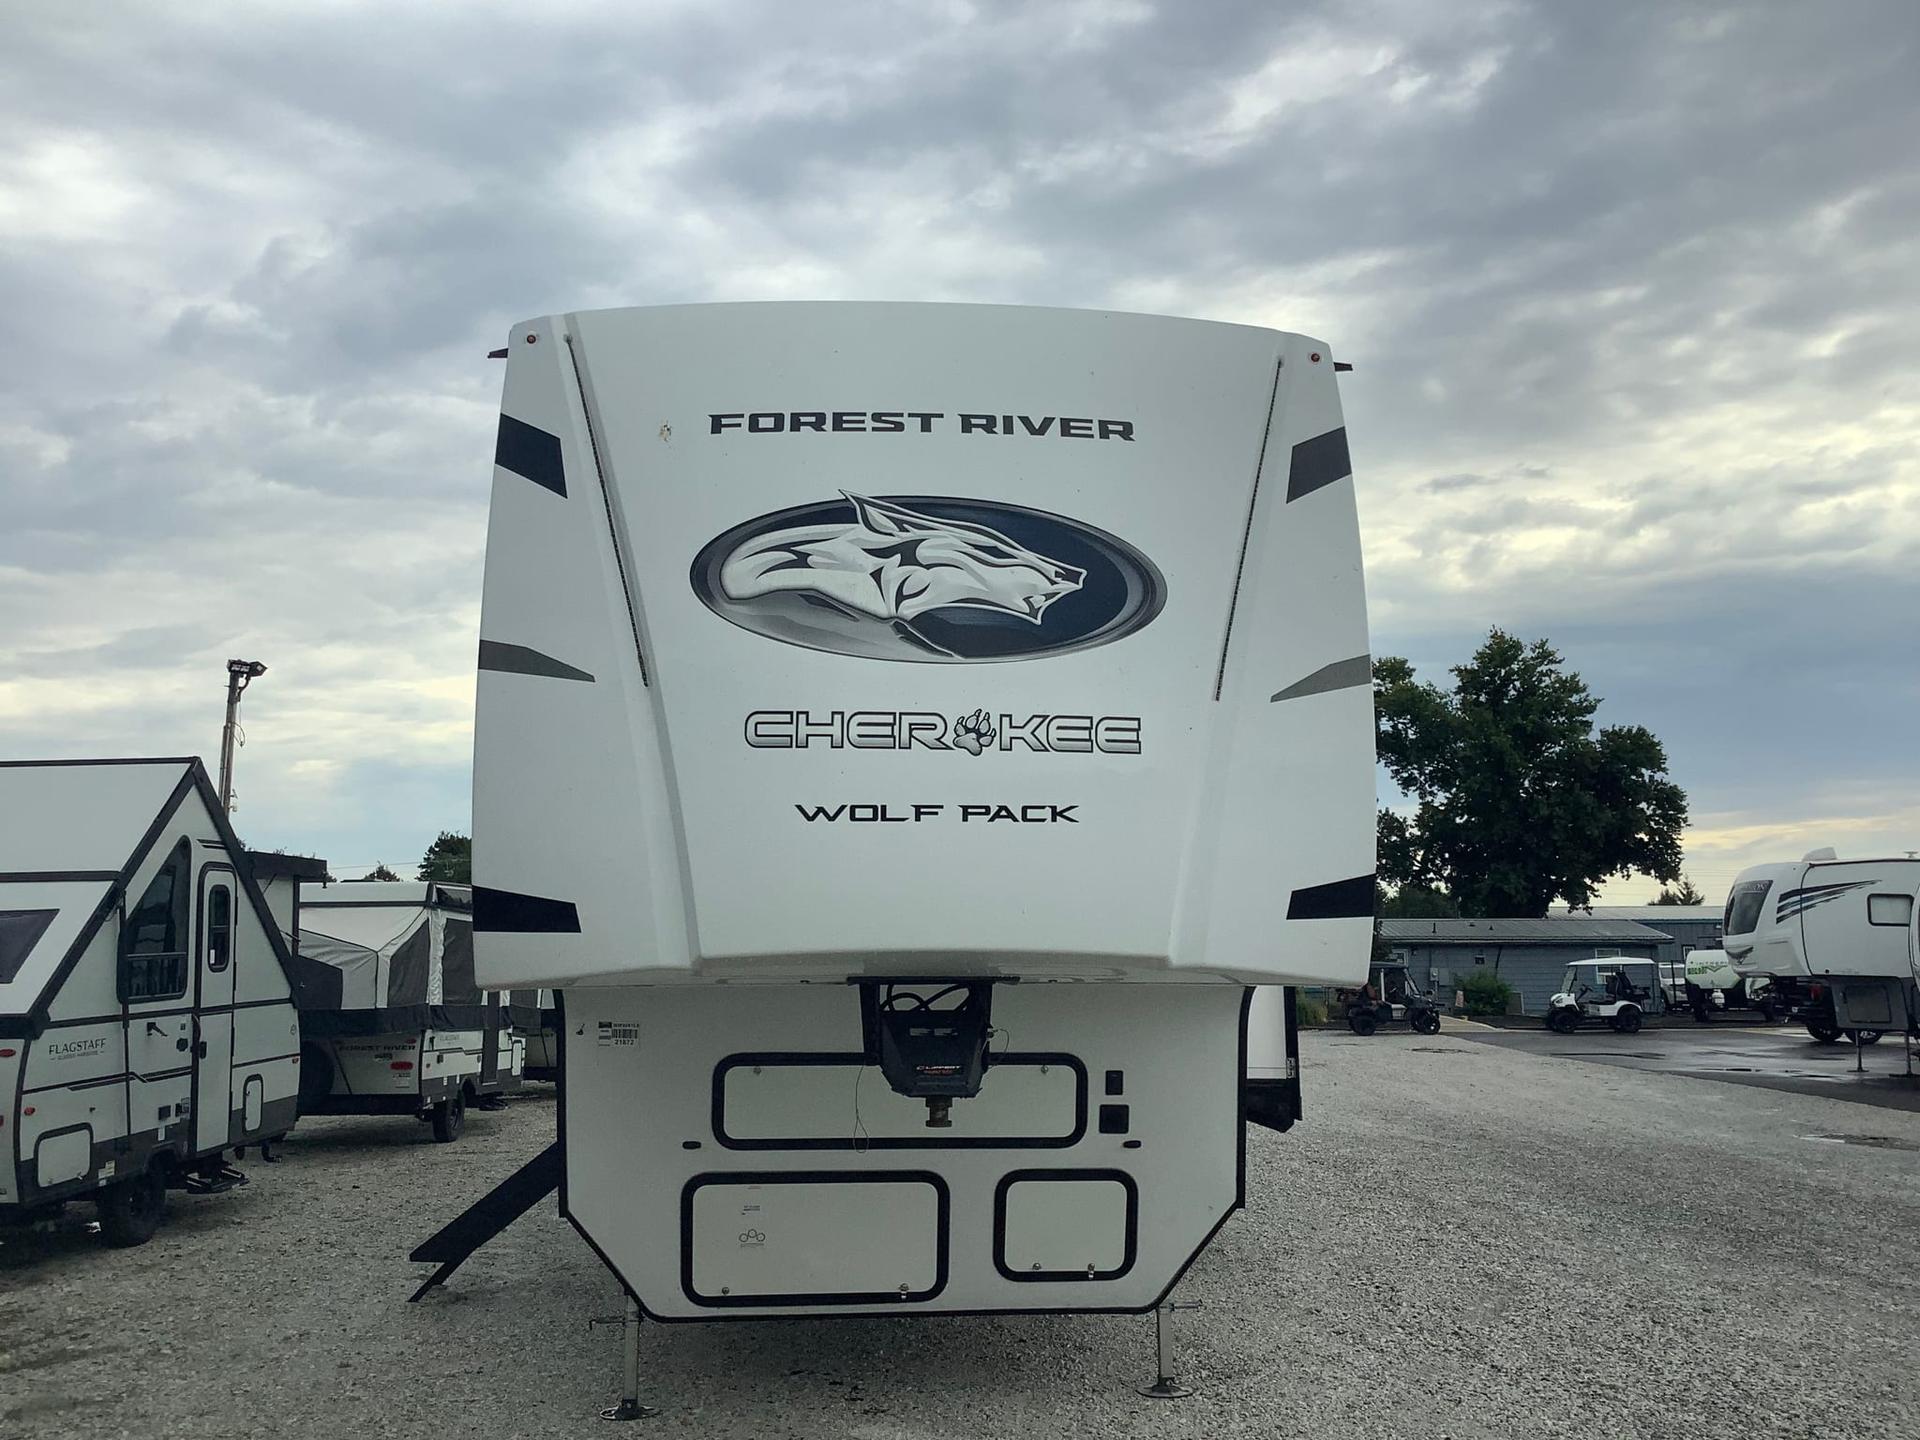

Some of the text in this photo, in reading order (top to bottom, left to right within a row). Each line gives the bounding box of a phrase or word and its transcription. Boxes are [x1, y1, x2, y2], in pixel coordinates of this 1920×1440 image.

[708, 411, 1136, 442] FOREST RIVER
[794, 804, 1080, 823] WOLF PACK
[49, 1037, 106, 1055] FLAGSTAFF
